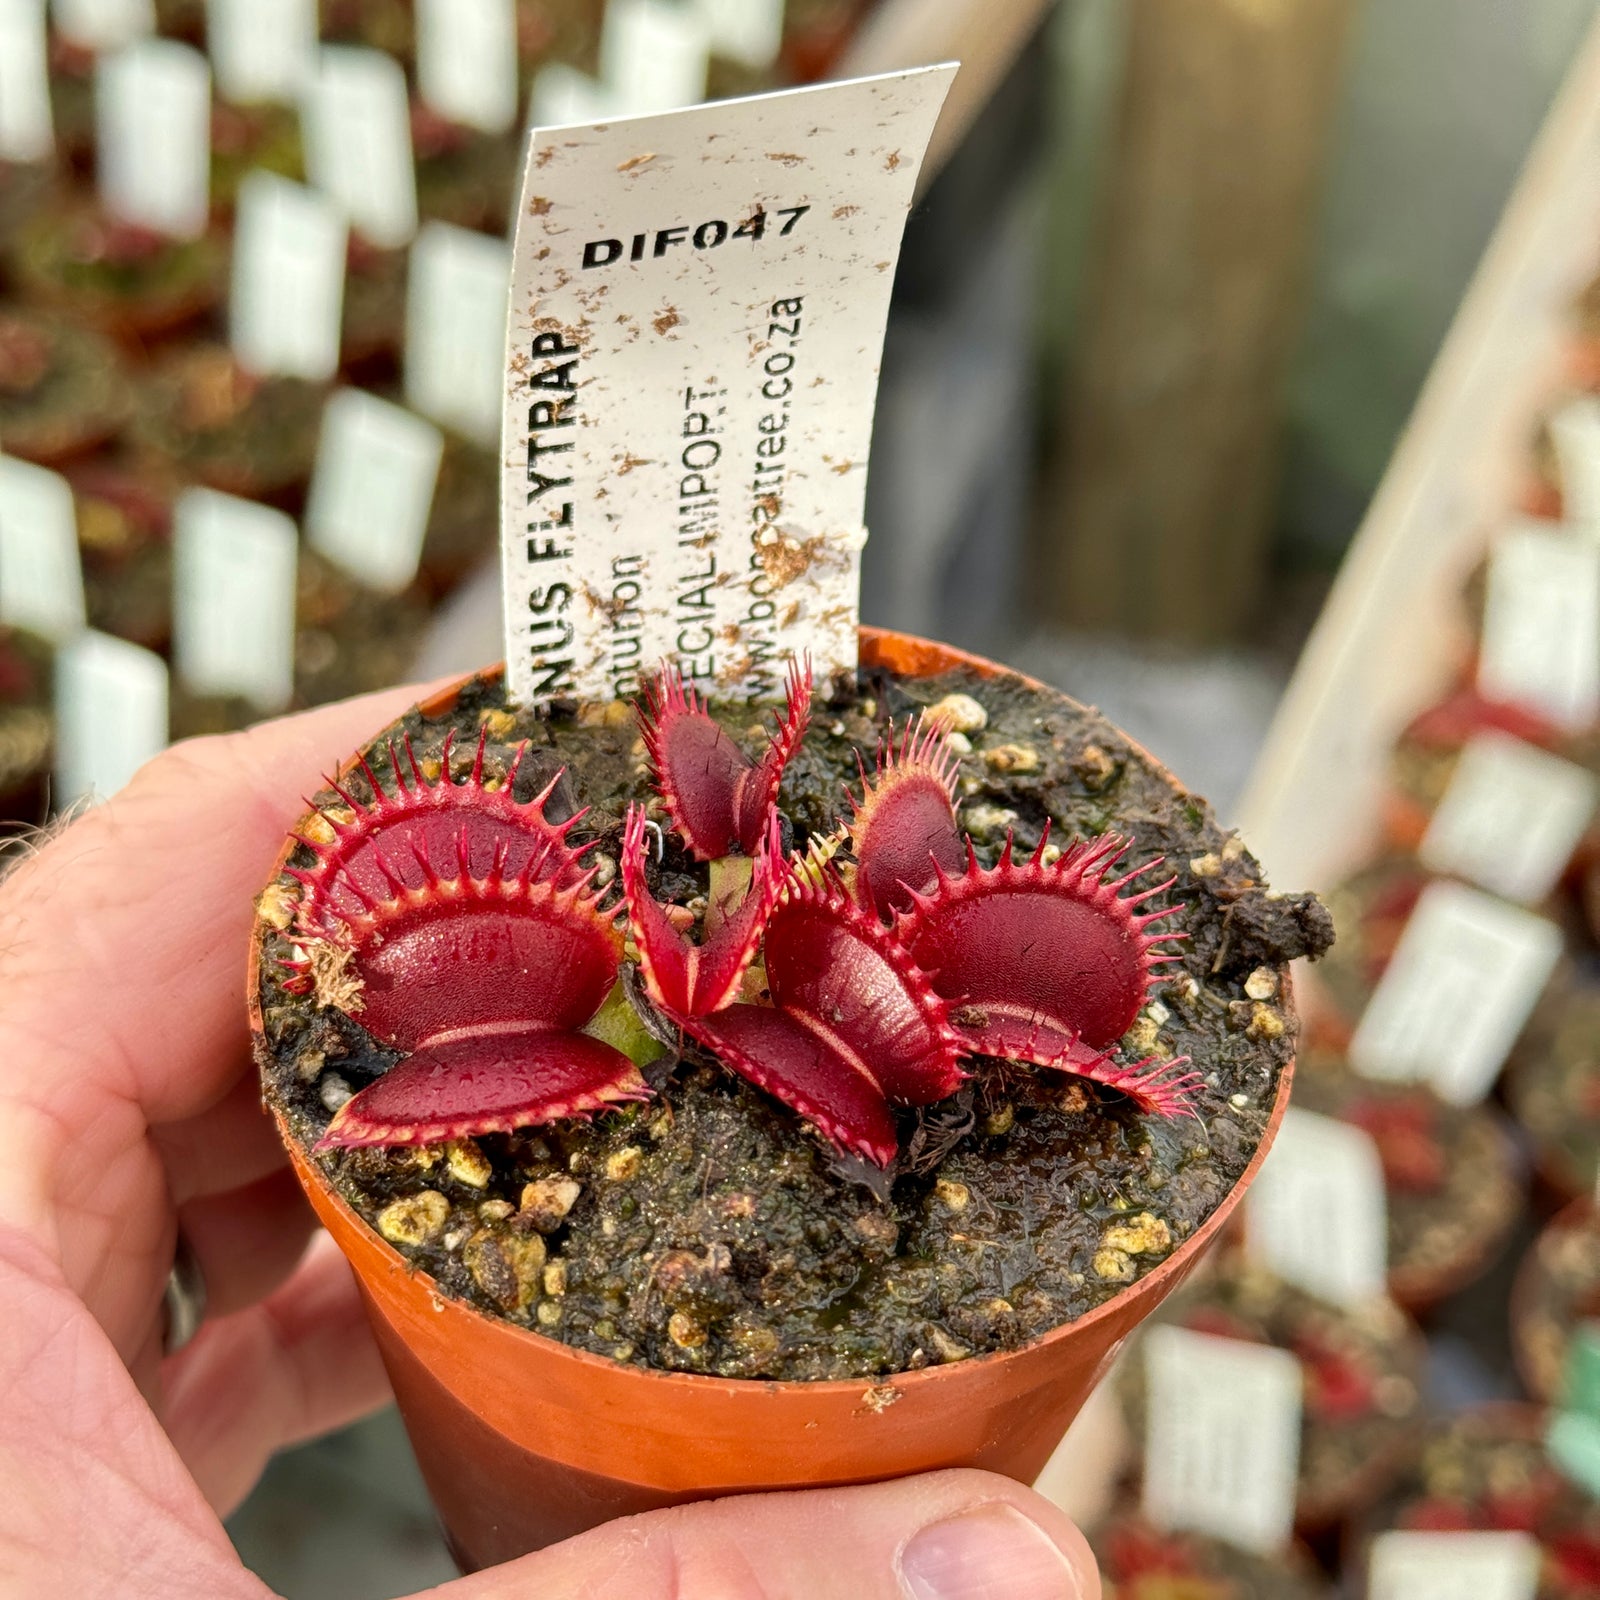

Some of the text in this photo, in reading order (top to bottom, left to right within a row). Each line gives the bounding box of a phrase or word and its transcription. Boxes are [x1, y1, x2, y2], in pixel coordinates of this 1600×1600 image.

[582, 205, 811, 270] DIF047
[527, 331, 581, 704] NUS FLYTRAP
[605, 554, 642, 699] nturion
[676, 386, 728, 682] ECIAL IMPORT
